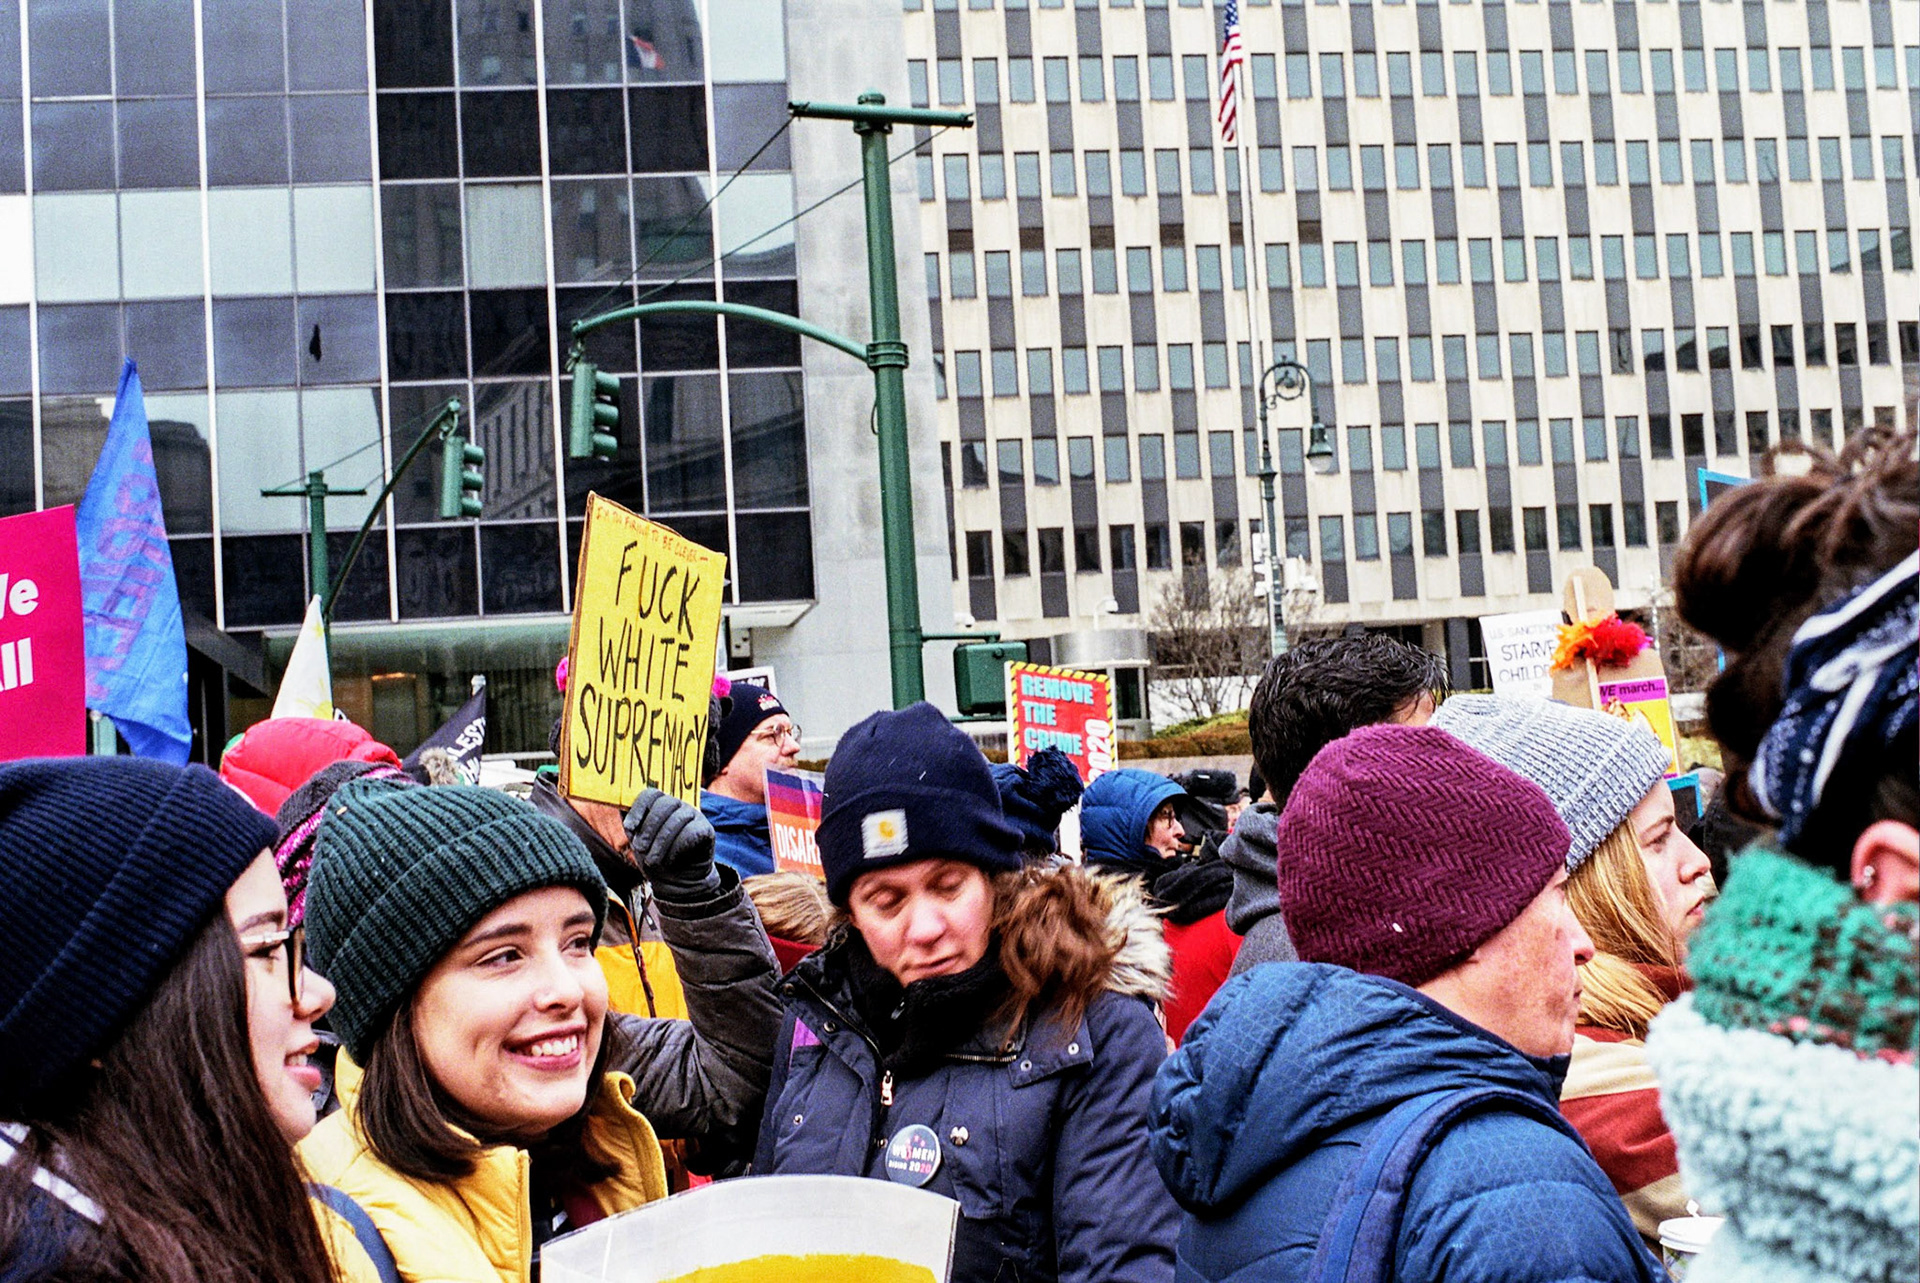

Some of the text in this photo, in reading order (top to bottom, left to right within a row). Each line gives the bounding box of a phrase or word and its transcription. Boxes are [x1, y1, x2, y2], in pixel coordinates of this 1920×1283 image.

[615, 540, 700, 641] FUCK
[0, 637, 34, 692] ll
[599, 616, 690, 702] WHITE
[1021, 674, 1094, 705] REMOVE
[1022, 700, 1057, 727] THE
[576, 683, 708, 807] SUPREMACY
[1024, 727, 1083, 757] CRIME
[909, 1161, 932, 1173] 2020
